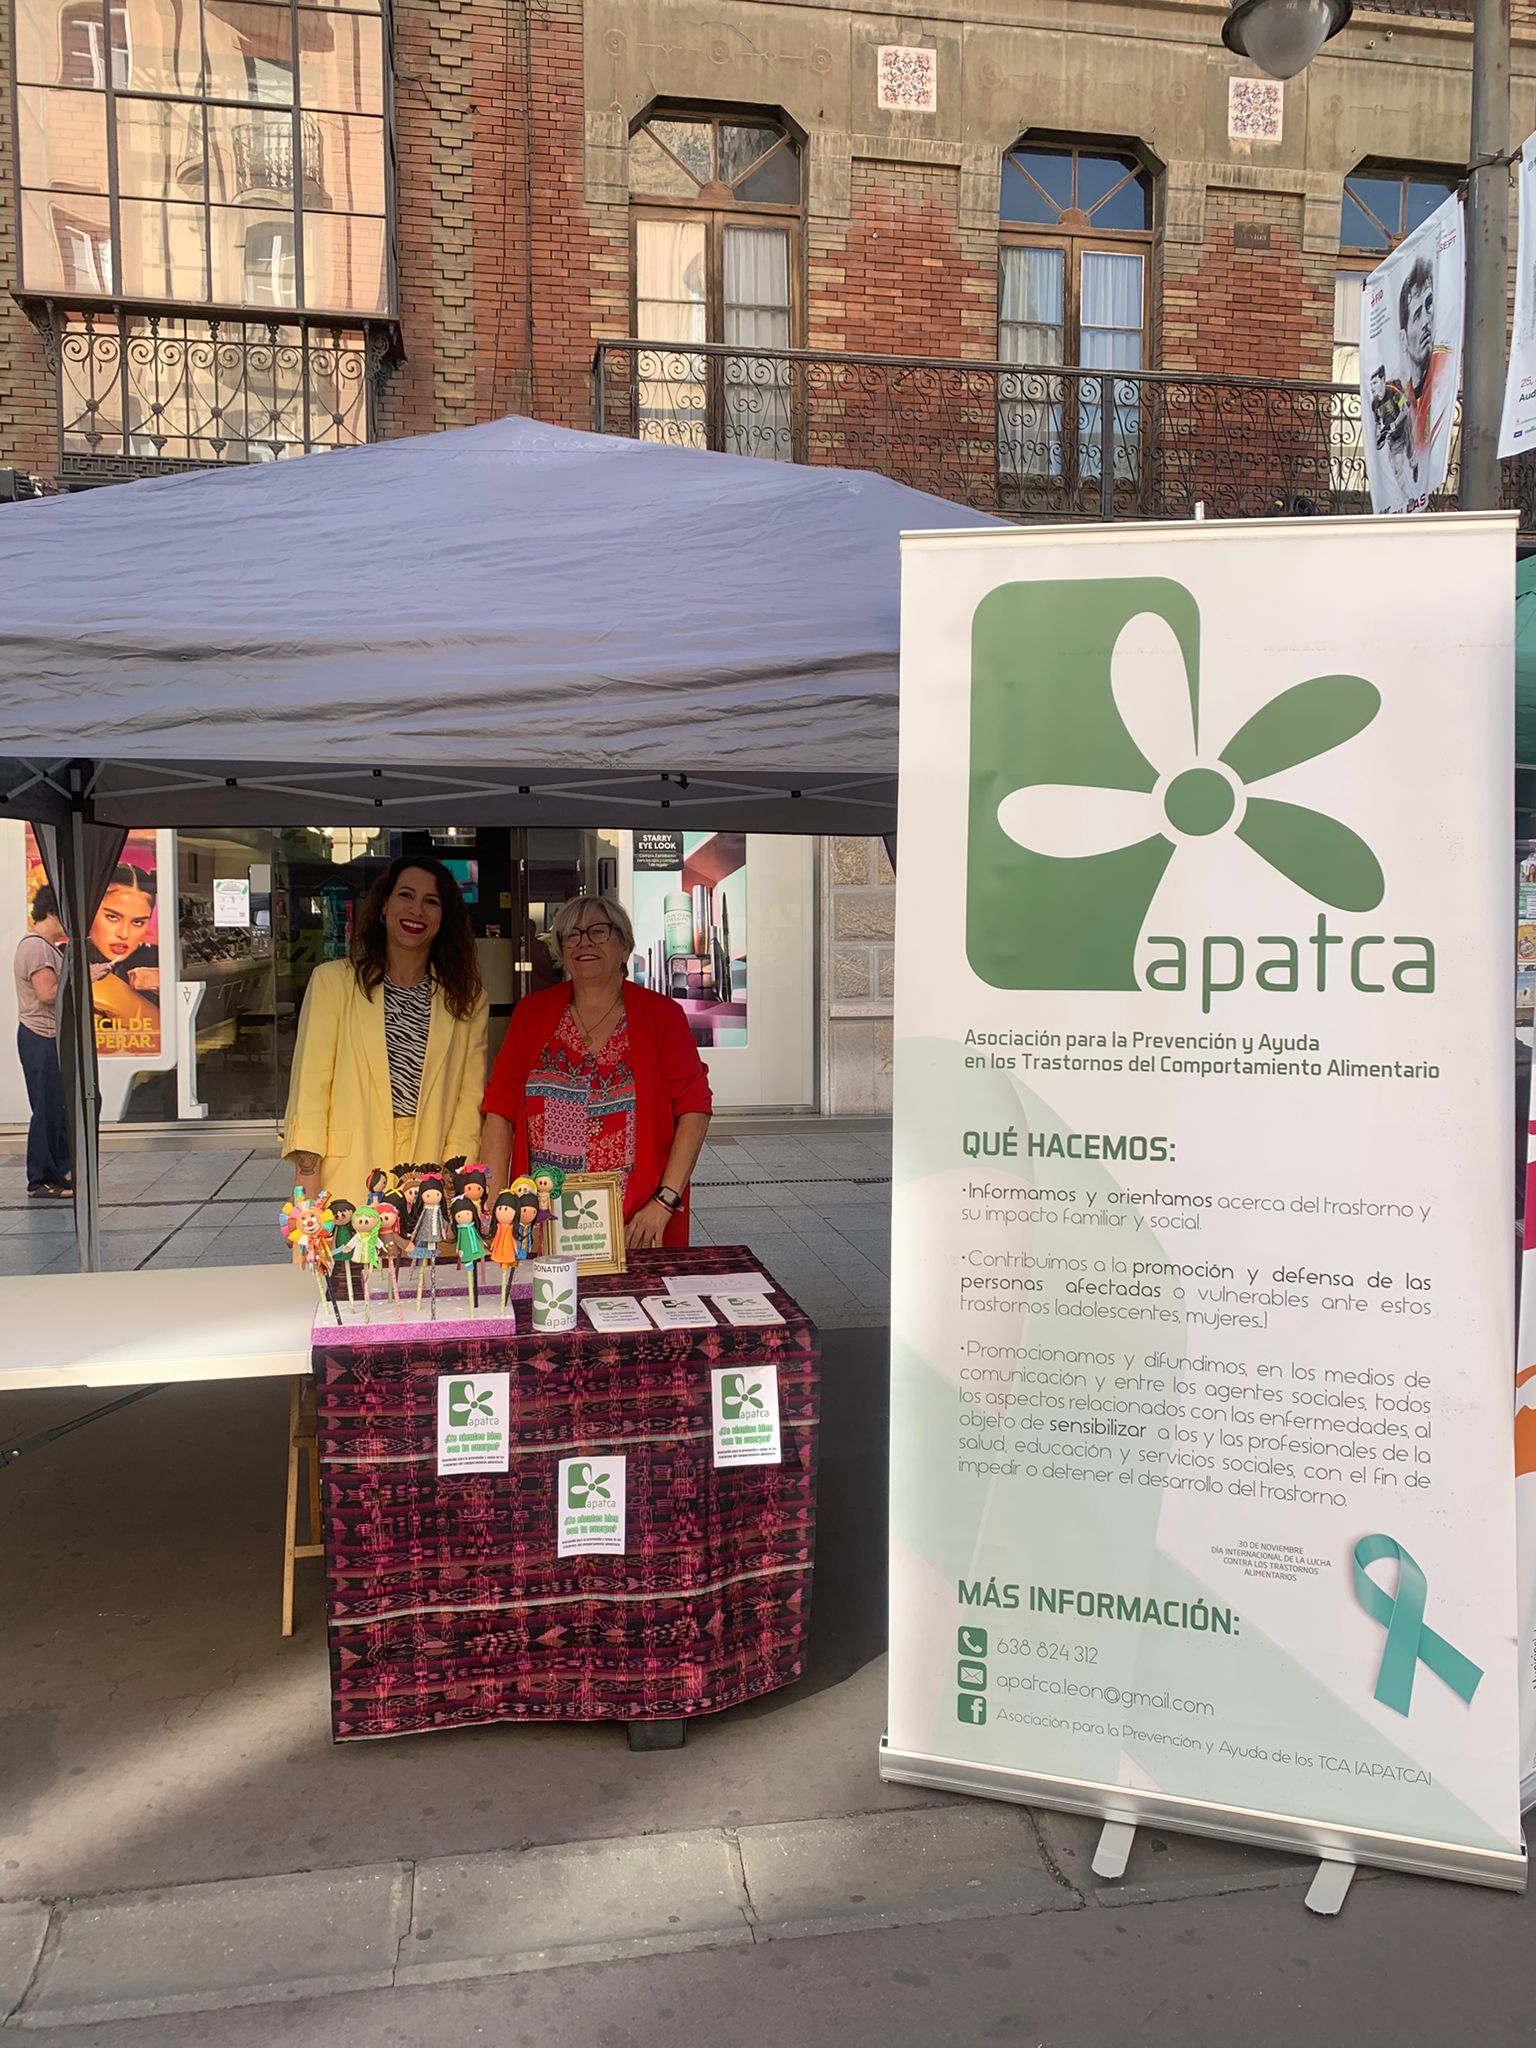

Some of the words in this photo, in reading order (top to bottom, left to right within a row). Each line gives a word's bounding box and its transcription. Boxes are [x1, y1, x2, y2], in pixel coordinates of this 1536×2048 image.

[642, 834, 672, 842] STARRY
[654, 842, 676, 850] LOOK
[1145, 912, 1435, 1014] apatca
[129, 1017, 153, 1031] DE
[96, 1034, 156, 1049] PERAR.
[964, 1029, 1061, 1046] Asociación
[1066, 1035, 1107, 1051] para
[1112, 1031, 1127, 1048] la
[1133, 1031, 1236, 1050] Prevención
[1242, 1037, 1253, 1054] y
[1258, 1033, 1320, 1055] Ayuda
[964, 1057, 986, 1069] en
[991, 1053, 1016, 1069] los
[1022, 1054, 1123, 1072] Trastornos
[1128, 1056, 1155, 1073] del
[1160, 1056, 1322, 1078] Comportamiento
[1327, 1059, 1440, 1079] Alimentario
[963, 1126, 1018, 1159] QUÉ
[1028, 1132, 1176, 1162] HACEMOS:
[961, 1208, 980, 1221] su
[986, 1205, 1058, 1226] impacto
[1063, 1208, 1126, 1227] familiar
[1133, 1215, 1144, 1232] y
[1150, 1212, 1202, 1230] social.
[1085, 1191, 1097, 1208] y
[1107, 1188, 1212, 1208] orientamos
[1217, 1196, 1285, 1212] acerca
[1290, 1196, 1319, 1213] del
[1324, 1196, 1413, 1217] trastorno
[1419, 1205, 1431, 1223] y
[1094, 1259, 1106, 1272] a
[1112, 1256, 1127, 1273] la
[1133, 1261, 1234, 1279] promoción
[1247, 1268, 1259, 1286] y
[1272, 1266, 1354, 1287] defensa
[1367, 1271, 1393, 1289] de
[1406, 1272, 1431, 1291] las
[960, 1276, 1043, 1293] personas
[1065, 1278, 1161, 1298] afectadas
[1173, 1287, 1185, 1299] o
[1197, 1286, 1309, 1308] vulnerables
[1321, 1294, 1368, 1312] ante
[1381, 1296, 1431, 1315] estos
[960, 1295, 1050, 1315] trastornos
[1124, 1354, 1135, 1370] y
[1257, 1364, 1282, 1378] en
[1291, 1362, 1315, 1381] los
[1325, 1368, 1394, 1387] medios
[1404, 1370, 1431, 1389] de
[959, 1366, 1086, 1386] comunicación
[1094, 1376, 1106, 1392] y
[1114, 1374, 1165, 1392] entre
[1173, 1376, 1196, 1394] los
[1204, 1384, 1283, 1403] agentes
[1291, 1390, 1367, 1411] sociales,
[1375, 1393, 1431, 1414] todos
[468, 1417, 500, 1428] apatca
[740, 1409, 769, 1420] apatca
[959, 1387, 981, 1404] los
[985, 1391, 1065, 1410] aspectos
[1069, 1394, 1186, 1418] relacionados
[1190, 1407, 1227, 1422] con
[1231, 1406, 1254, 1425] las
[1259, 1410, 1410, 1439] enfermedades,
[1414, 1421, 1431, 1439] al
[959, 1410, 1015, 1432] objeto
[1021, 1414, 1044, 1431] de
[1050, 1417, 1147, 1438] sensibilizar
[1157, 1427, 1170, 1440] a
[1174, 1425, 1197, 1443] los
[1203, 1431, 1215, 1449] y
[1220, 1429, 1243, 1447] las
[1249, 1434, 1377, 1460] profesionales
[1382, 1444, 1409, 1462] de
[1414, 1445, 1431, 1464] la
[959, 1434, 1007, 1453] salud,
[1015, 1437, 1112, 1459] educación
[1119, 1448, 1131, 1464] y
[1138, 1449, 1215, 1469] servicios
[1222, 1457, 1296, 1479] sociales,
[1304, 1466, 1342, 1481] con
[1350, 1466, 1366, 1484] el
[1374, 1467, 1397, 1486] fin
[1404, 1471, 1431, 1489] de
[958, 1456, 1021, 1478] impedir
[1026, 1464, 1038, 1477] o
[1042, 1462, 1113, 1483] detener
[1119, 1468, 1134, 1485] el
[1138, 1470, 1223, 1493] desarrollo
[1228, 1479, 1255, 1497] del
[1260, 1481, 1348, 1507] trastorno.
[586, 1499, 617, 1510] apatca
[1211, 1545, 1224, 1555] DÍA
[1225, 1548, 1282, 1562] INTERNACIONAL
[1284, 1554, 1294, 1563] DE
[1295, 1556, 1305, 1564] LA
[1306, 1558, 1331, 1567] LUCHA
[1238, 1540, 1248, 1548] 30
[1249, 1541, 1259, 1549] DE
[1260, 1543, 1304, 1555] NOVIEMBRE
[1223, 1556, 1253, 1566] CONTRA
[1254, 1560, 1268, 1569] LOS
[1270, 1562, 1319, 1575] TRASTORNOS
[1244, 1568, 1297, 1581] ALIMENTARIOS
[958, 1576, 1020, 1609] MÁS
[1029, 1586, 1240, 1636] INFORMACIÓN:
[996, 1637, 1031, 1656] 638
[1036, 1641, 1069, 1661] 824
[1074, 1645, 1098, 1665] 312
[996, 1673, 1215, 1716] apatca.leon@gmail.com
[996, 1707, 1070, 1730] Asociación
[1072, 1719, 1104, 1734] para
[1107, 1723, 1119, 1737] la
[1122, 1724, 1202, 1751] Prevención
[1205, 1741, 1214, 1754] y
[1218, 1740, 1268, 1760] Ayuda
[1271, 1750, 1291, 1764] de
[1295, 1752, 1313, 1767] los
[1318, 1755, 1351, 1774] TCA
